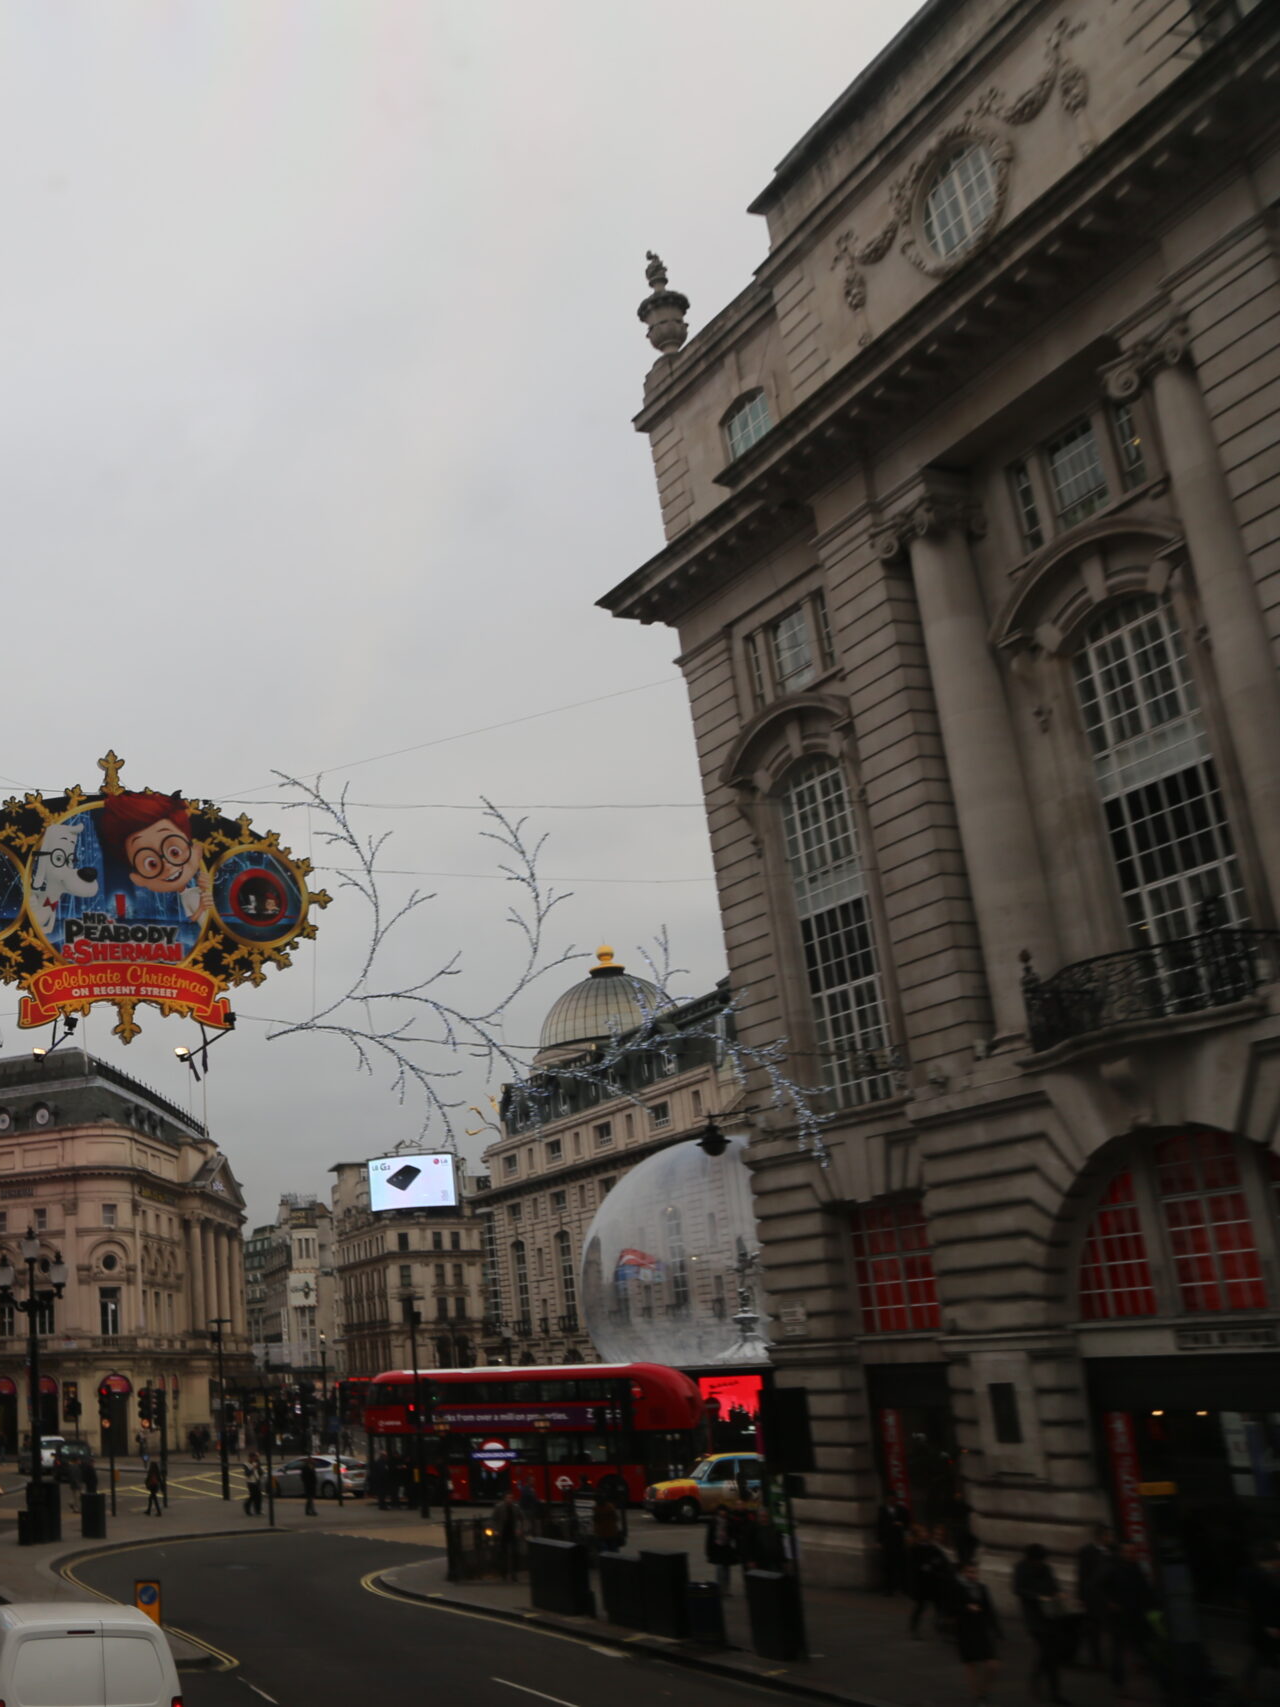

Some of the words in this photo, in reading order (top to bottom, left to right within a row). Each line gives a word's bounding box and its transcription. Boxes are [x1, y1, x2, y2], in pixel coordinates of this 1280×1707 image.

[65, 919, 178, 944] PEABODY
[74, 939, 183, 965] SHERMAN
[39, 969, 122, 995] Celebrate
[126, 965, 209, 997] Christmas
[71, 986, 90, 997] ON
[93, 985, 137, 996] REGENT
[140, 985, 179, 998] STREET
